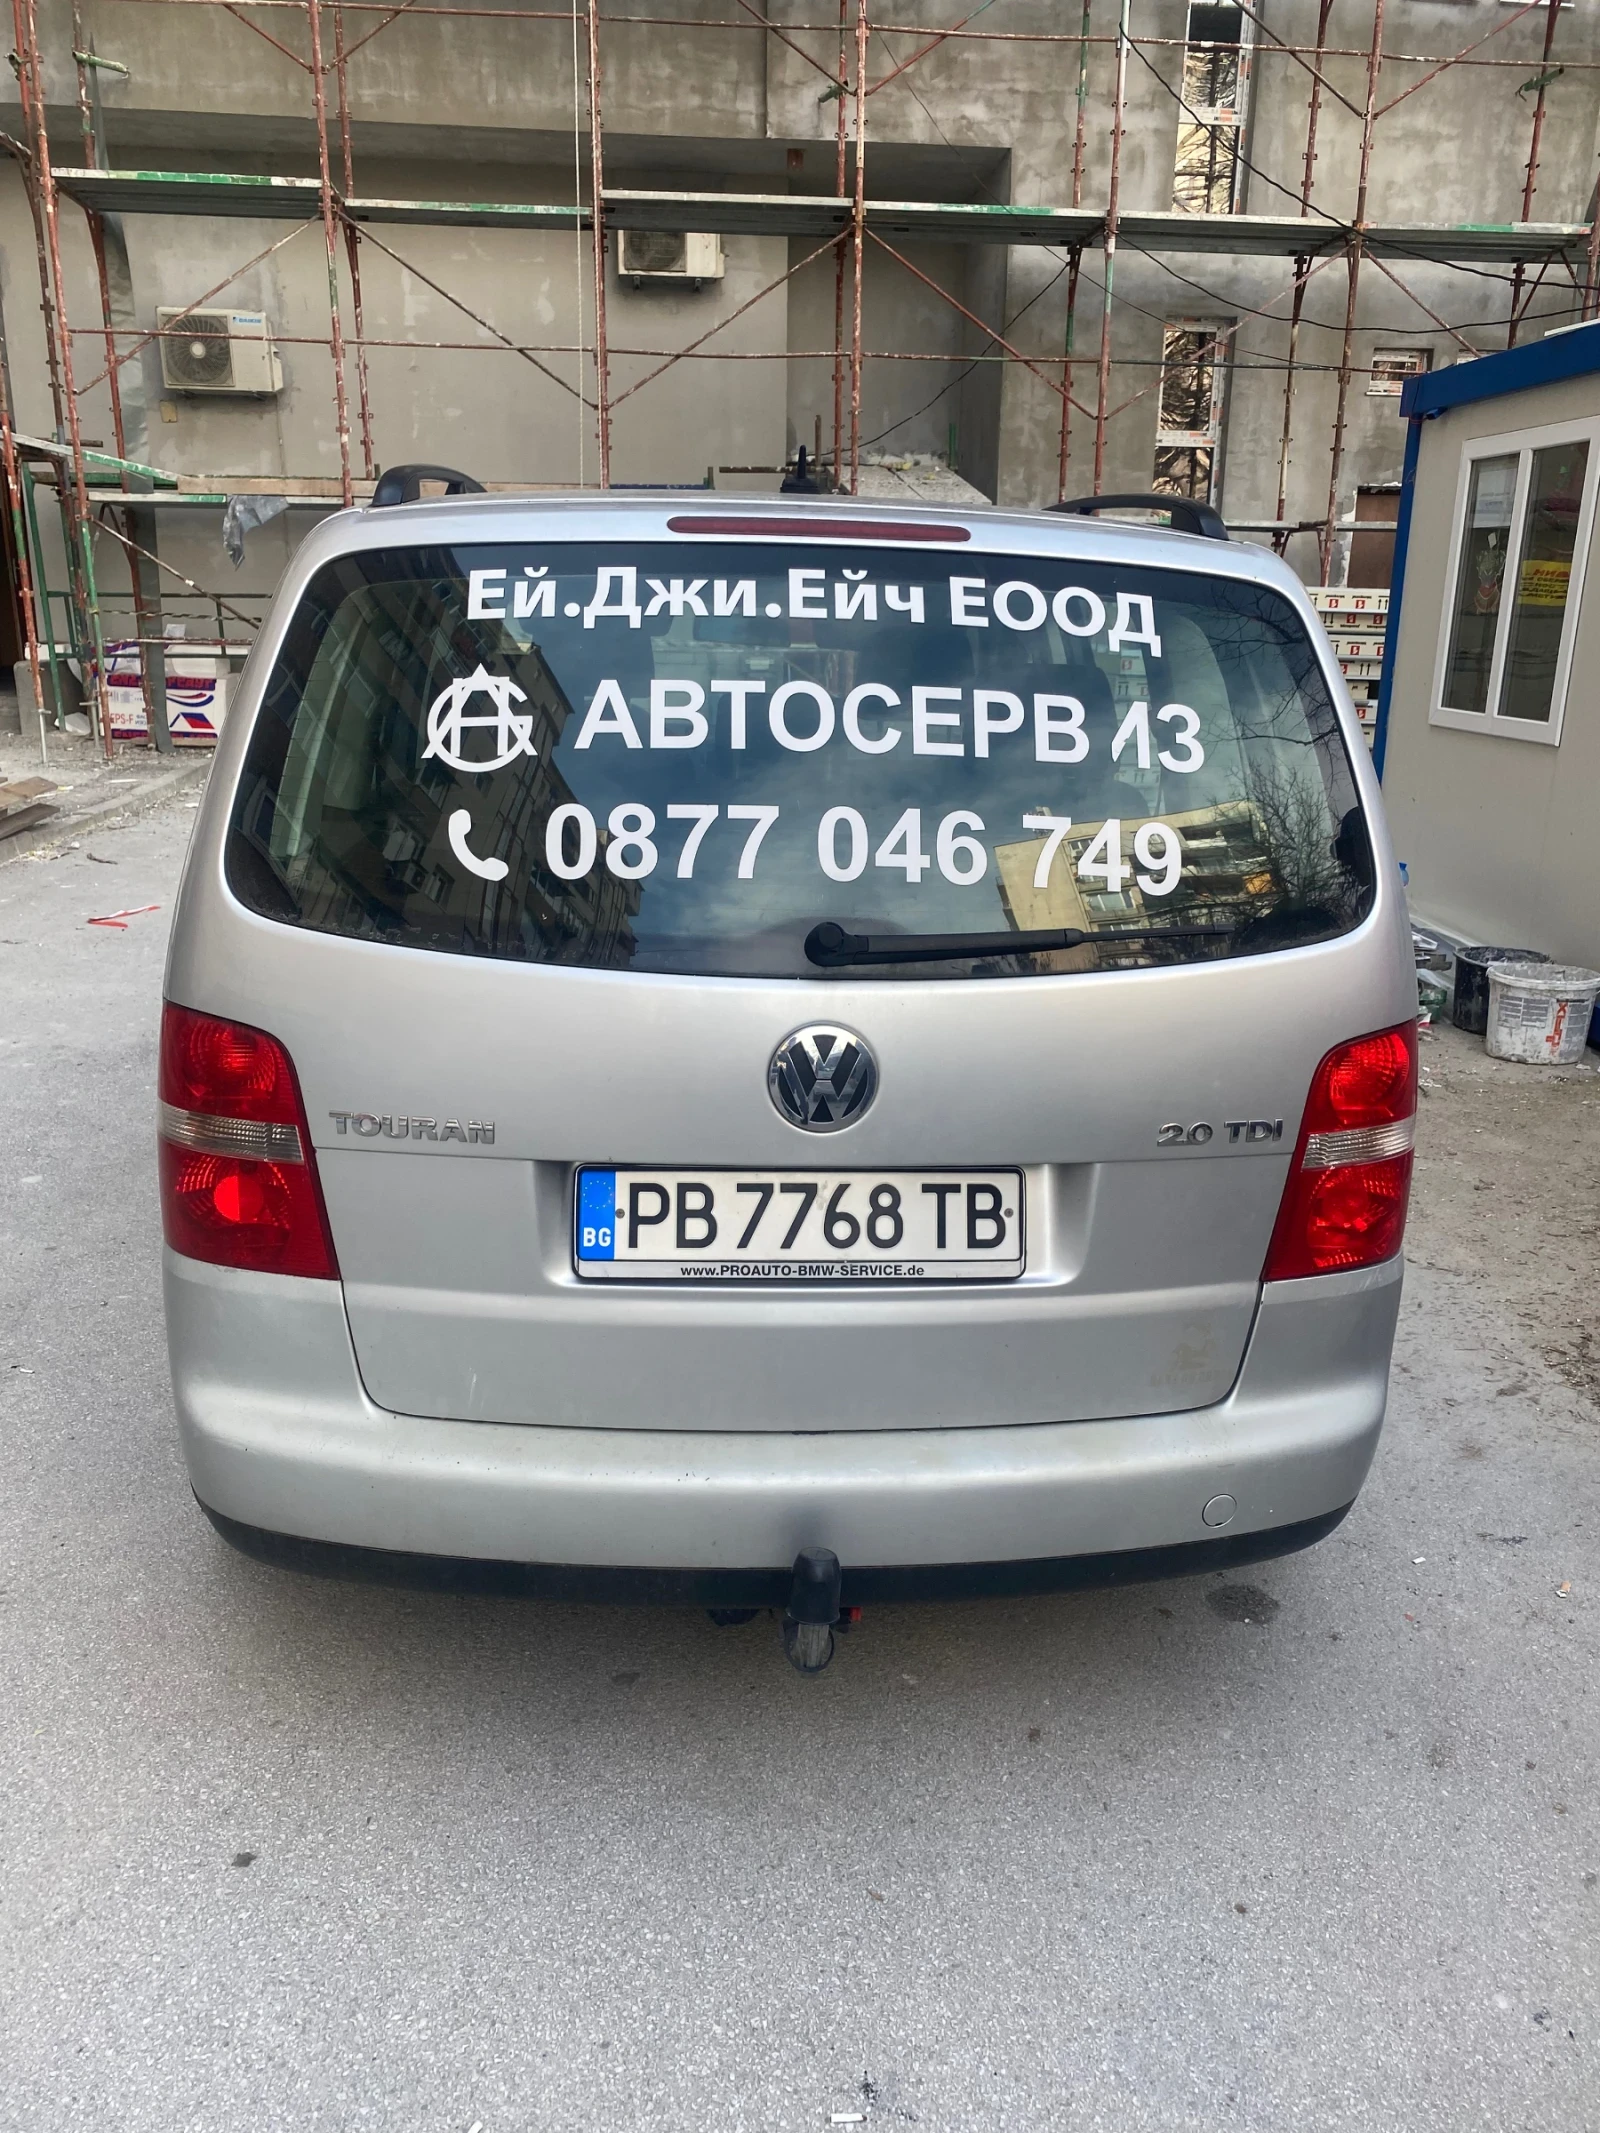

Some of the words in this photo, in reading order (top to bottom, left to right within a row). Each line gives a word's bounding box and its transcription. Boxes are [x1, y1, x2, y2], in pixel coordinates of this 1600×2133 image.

[467, 566, 928, 629] Ей.Джи.Ейч
[949, 576, 1162, 658] ЕООД
[545, 802, 780, 882] 0877
[818, 806, 988, 886] 046
[1023, 815, 1187, 896] 749
[329, 1110, 496, 1145] TOURAN
[1224, 1118, 1284, 1144] TDI
[583, 1227, 611, 1247] BG
[680, 1264, 925, 1277] www.PROAUTO-BMW-SERVICE.de
